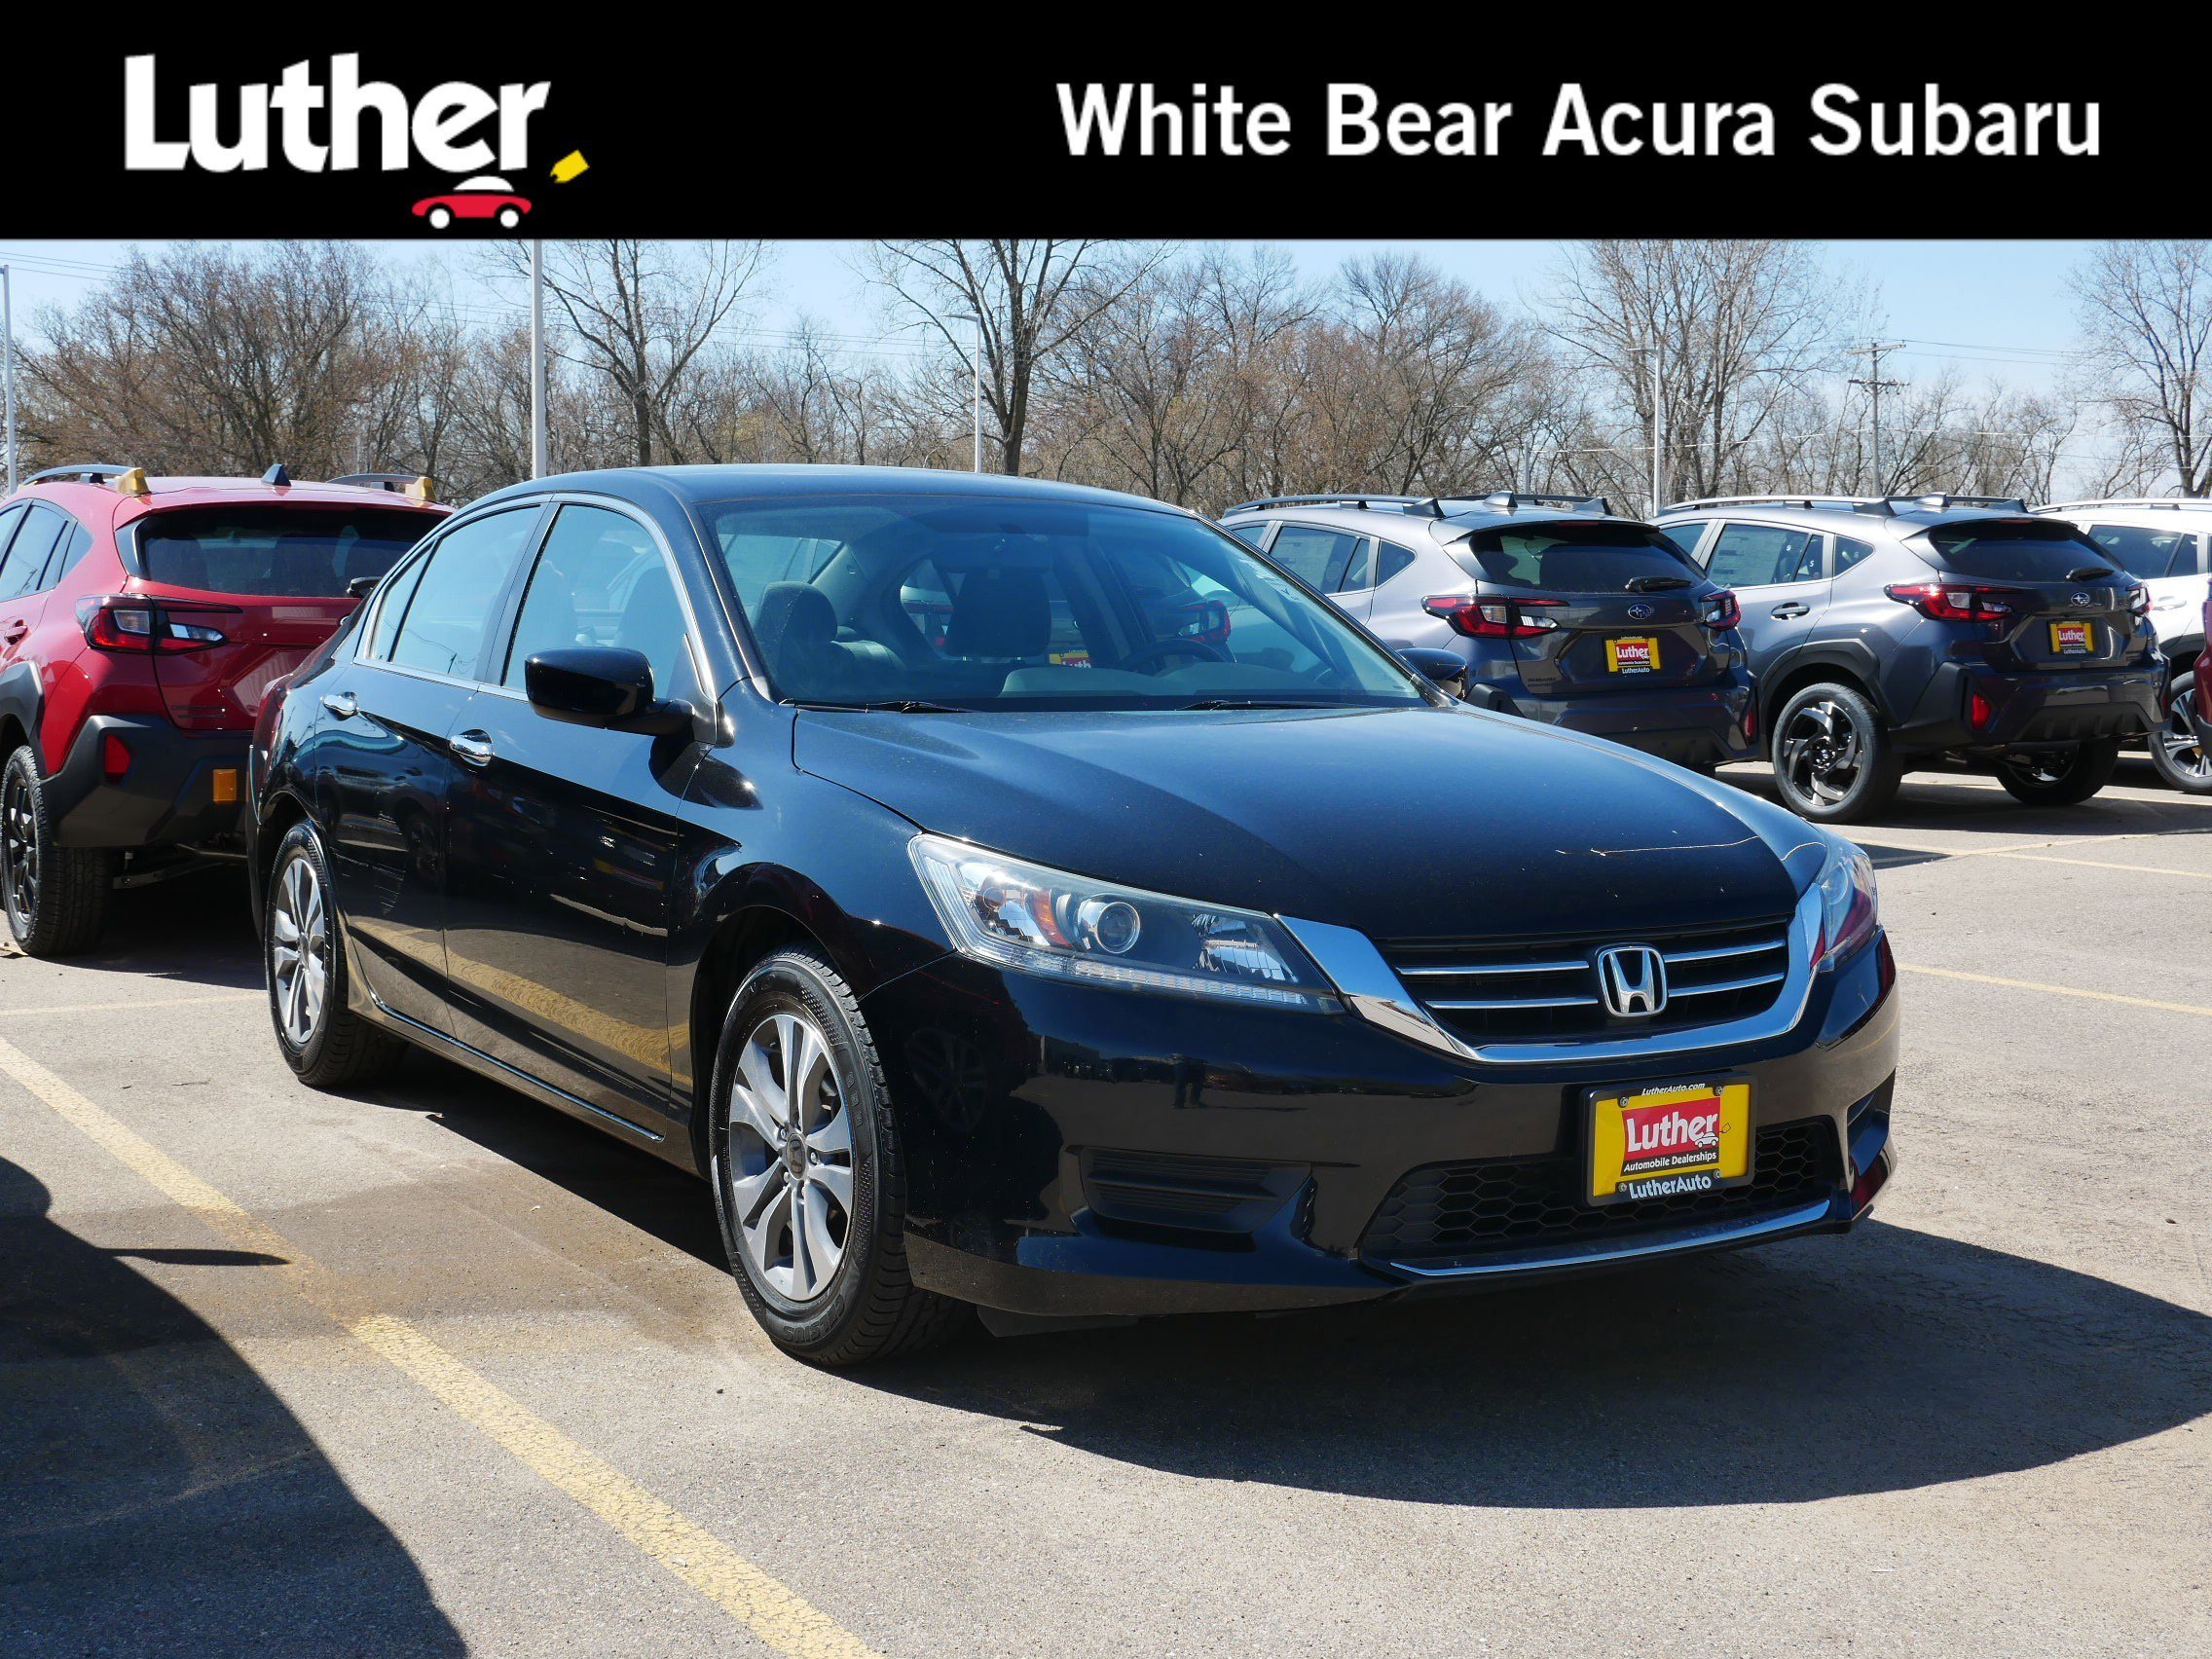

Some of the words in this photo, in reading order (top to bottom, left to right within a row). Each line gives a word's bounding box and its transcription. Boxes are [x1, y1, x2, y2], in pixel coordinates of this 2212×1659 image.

[2058, 629, 2085, 642] Luther
[1616, 645, 1649, 659] Luther
[1641, 1082, 1706, 1096] LutherAuto.com
[1626, 1111, 1718, 1153] Luther
[1623, 1158, 1670, 1172] Automobile
[1672, 1150, 1717, 1165] Dealerships
[1629, 1175, 1713, 1199] LutherAuto
